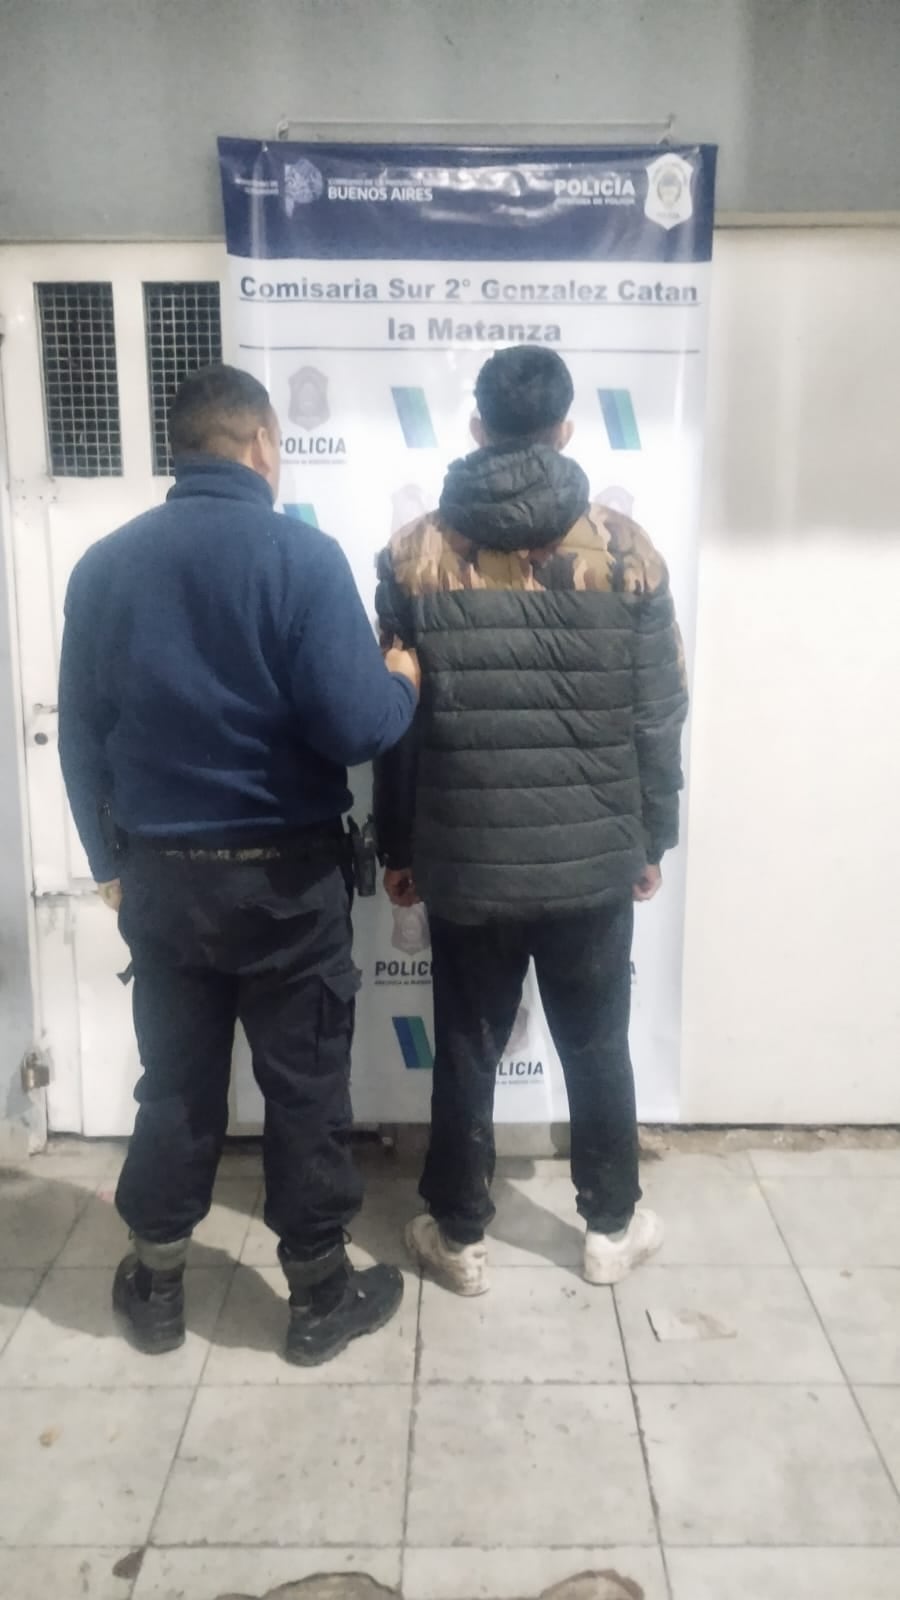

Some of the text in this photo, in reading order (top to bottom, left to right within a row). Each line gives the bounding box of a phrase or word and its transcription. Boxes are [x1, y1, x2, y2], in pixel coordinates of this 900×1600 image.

[328, 187, 433, 201] BUENOS AIRES
[240, 276, 378, 299] Comisaria
[388, 278, 435, 299] Sur
[481, 279, 607, 300] Gonzalez
[618, 280, 698, 301] Catan
[387, 317, 561, 342] la Matanza
[280, 437, 346, 454] OLICIA
[498, 1061, 544, 1076] LICIA
